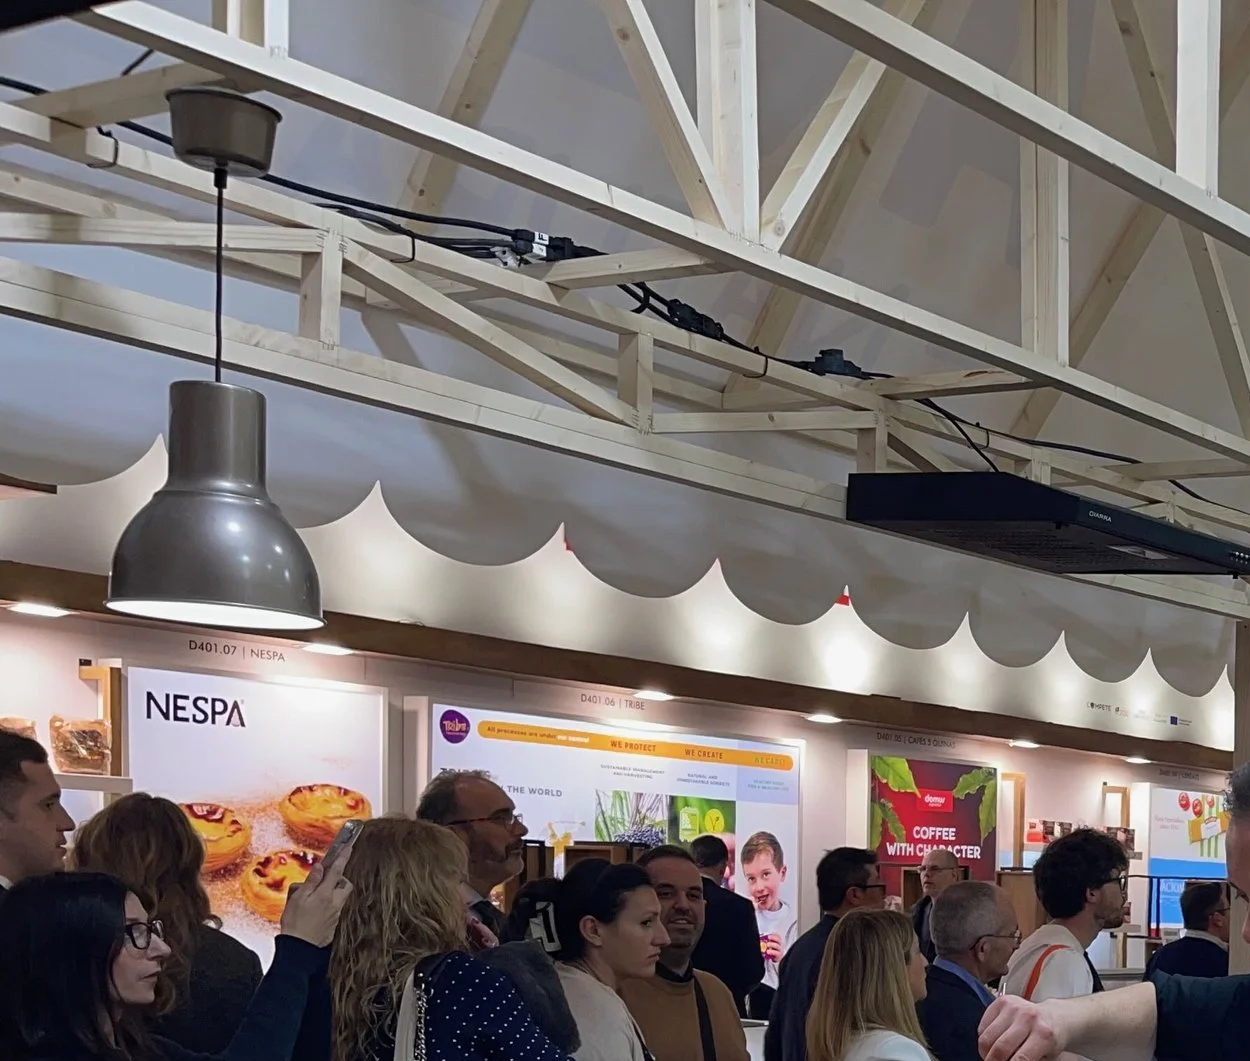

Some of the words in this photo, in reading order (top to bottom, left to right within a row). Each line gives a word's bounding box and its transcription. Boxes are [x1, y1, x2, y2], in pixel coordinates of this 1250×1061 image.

[188, 640, 237, 656] D401.07
[250, 649, 286, 662] NESPA
[580, 693, 616, 707] D401.06
[146, 691, 246, 727] NESPA
[610, 739, 623, 749] WE
[624, 742, 657, 753] PROTECT
[684, 748, 696, 757] WE
[697, 750, 724, 760] CREATE
[507, 785, 525, 795] THE
[528, 787, 563, 797] WORLD
[912, 826, 957, 841] COFFEE
[886, 842, 914, 857] WITH
